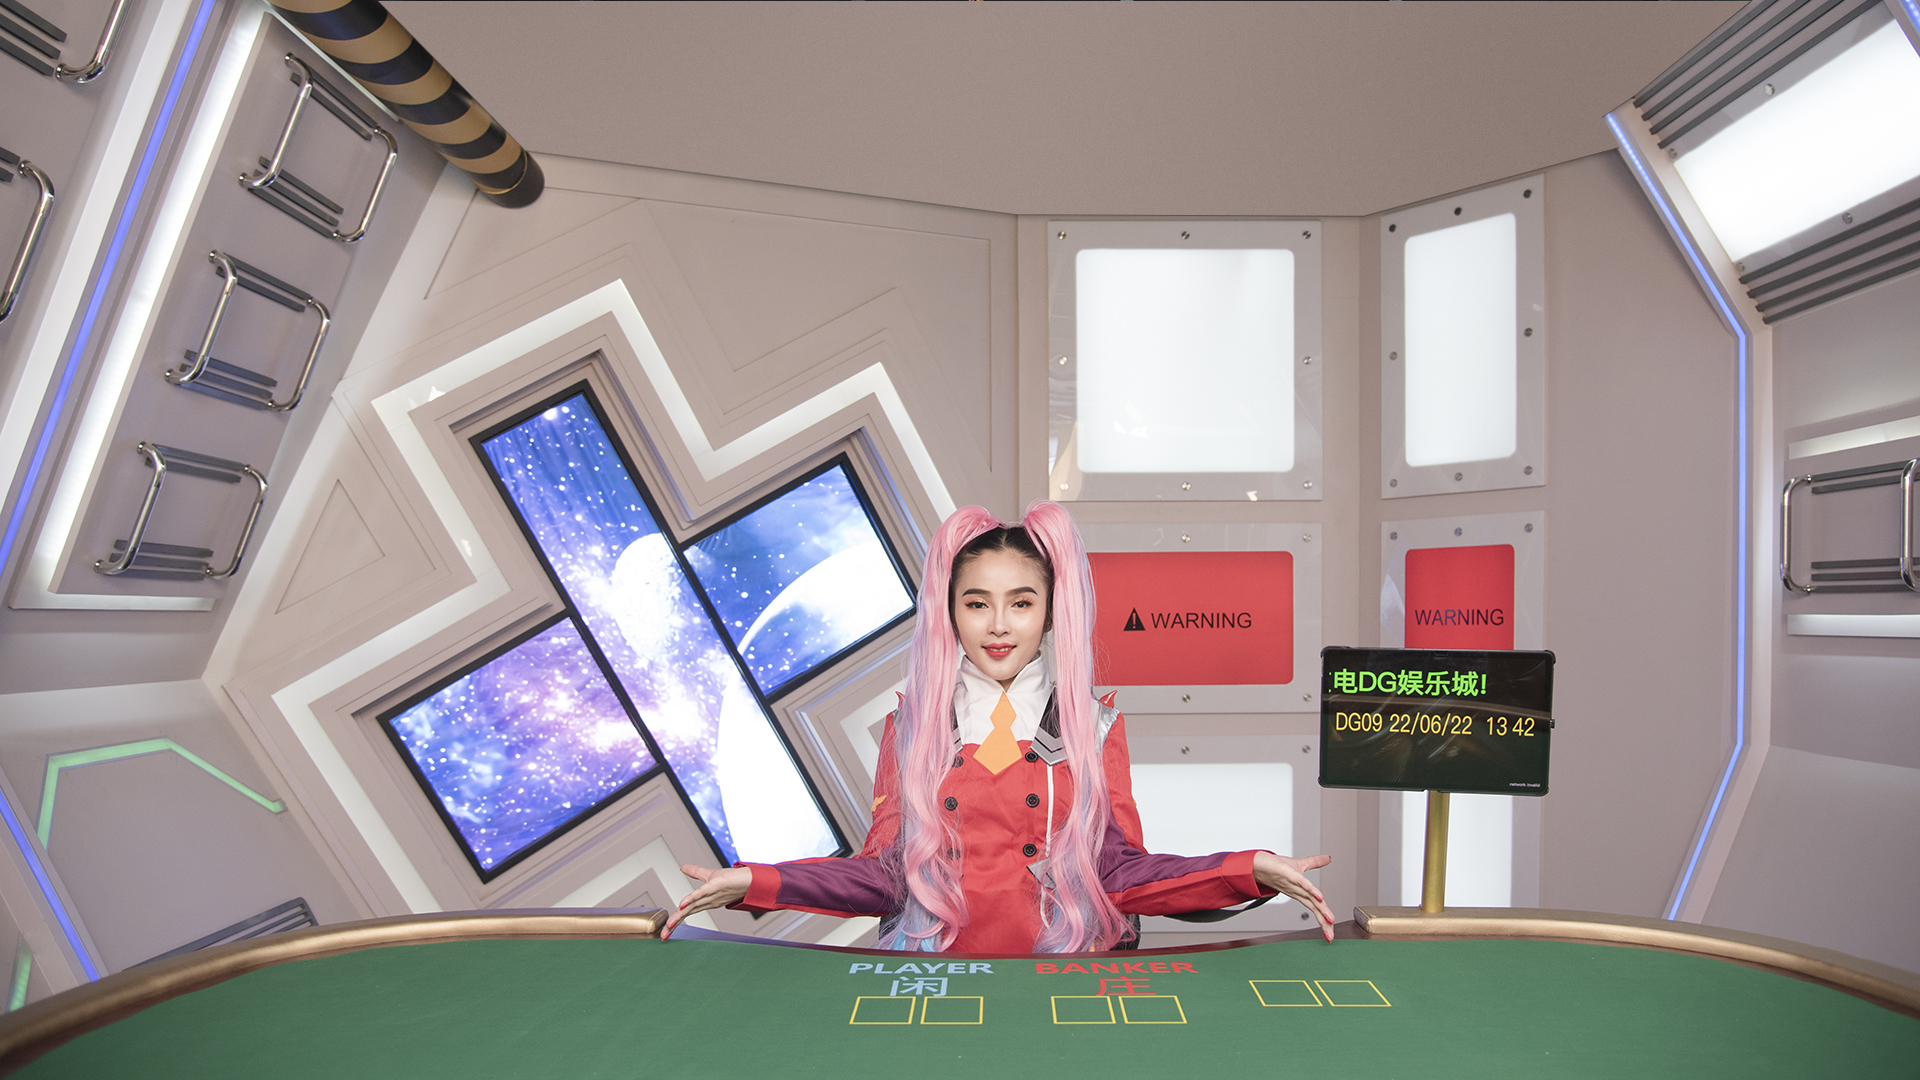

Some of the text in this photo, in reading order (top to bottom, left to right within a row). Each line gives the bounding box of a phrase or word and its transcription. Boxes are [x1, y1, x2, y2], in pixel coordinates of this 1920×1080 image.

[1151, 612, 1252, 629] WARNING
[1415, 608, 1504, 626] WARNING
[1328, 668, 1487, 697] 电DG娱乐城!
[1335, 712, 1383, 732] DG09
[1389, 711, 1473, 737] 22/06/22
[848, 962, 995, 975] PLAYER
[1035, 961, 1199, 974] BANKER
[889, 976, 949, 997] 闲
[1095, 975, 1157, 997] 庄
